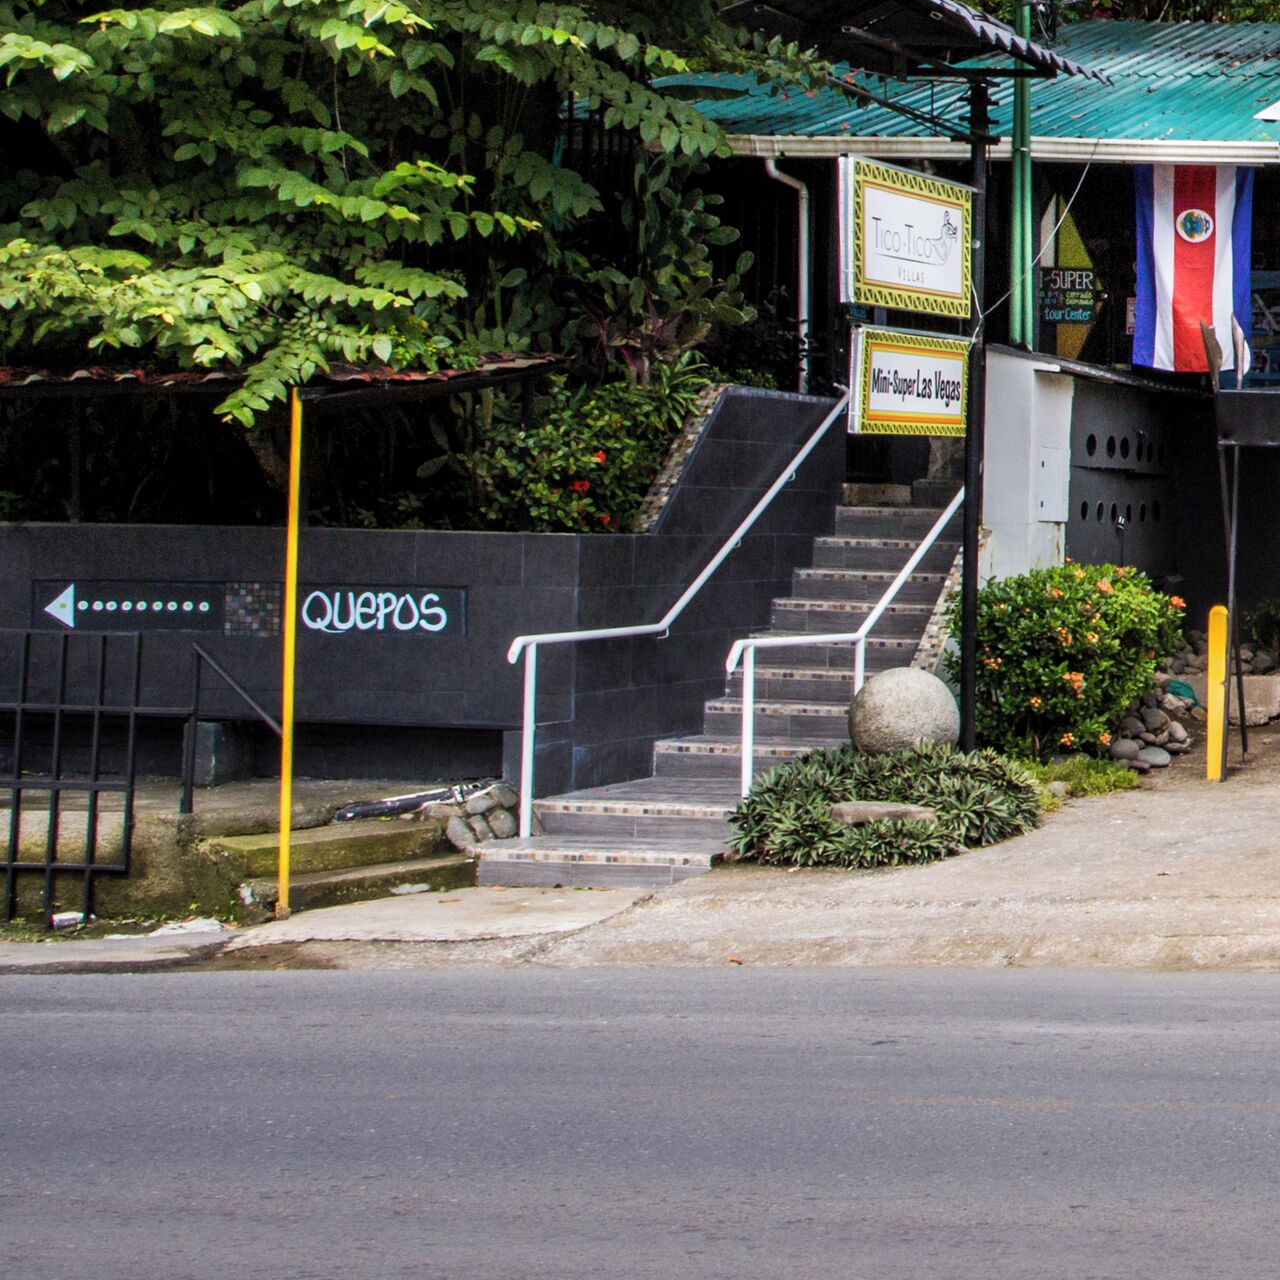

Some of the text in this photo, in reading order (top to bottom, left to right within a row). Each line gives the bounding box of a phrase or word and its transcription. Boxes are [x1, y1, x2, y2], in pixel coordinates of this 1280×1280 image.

[897, 265, 925, 284] VILLAS
[872, 368, 961, 408] Mini-Super Las Vegas
